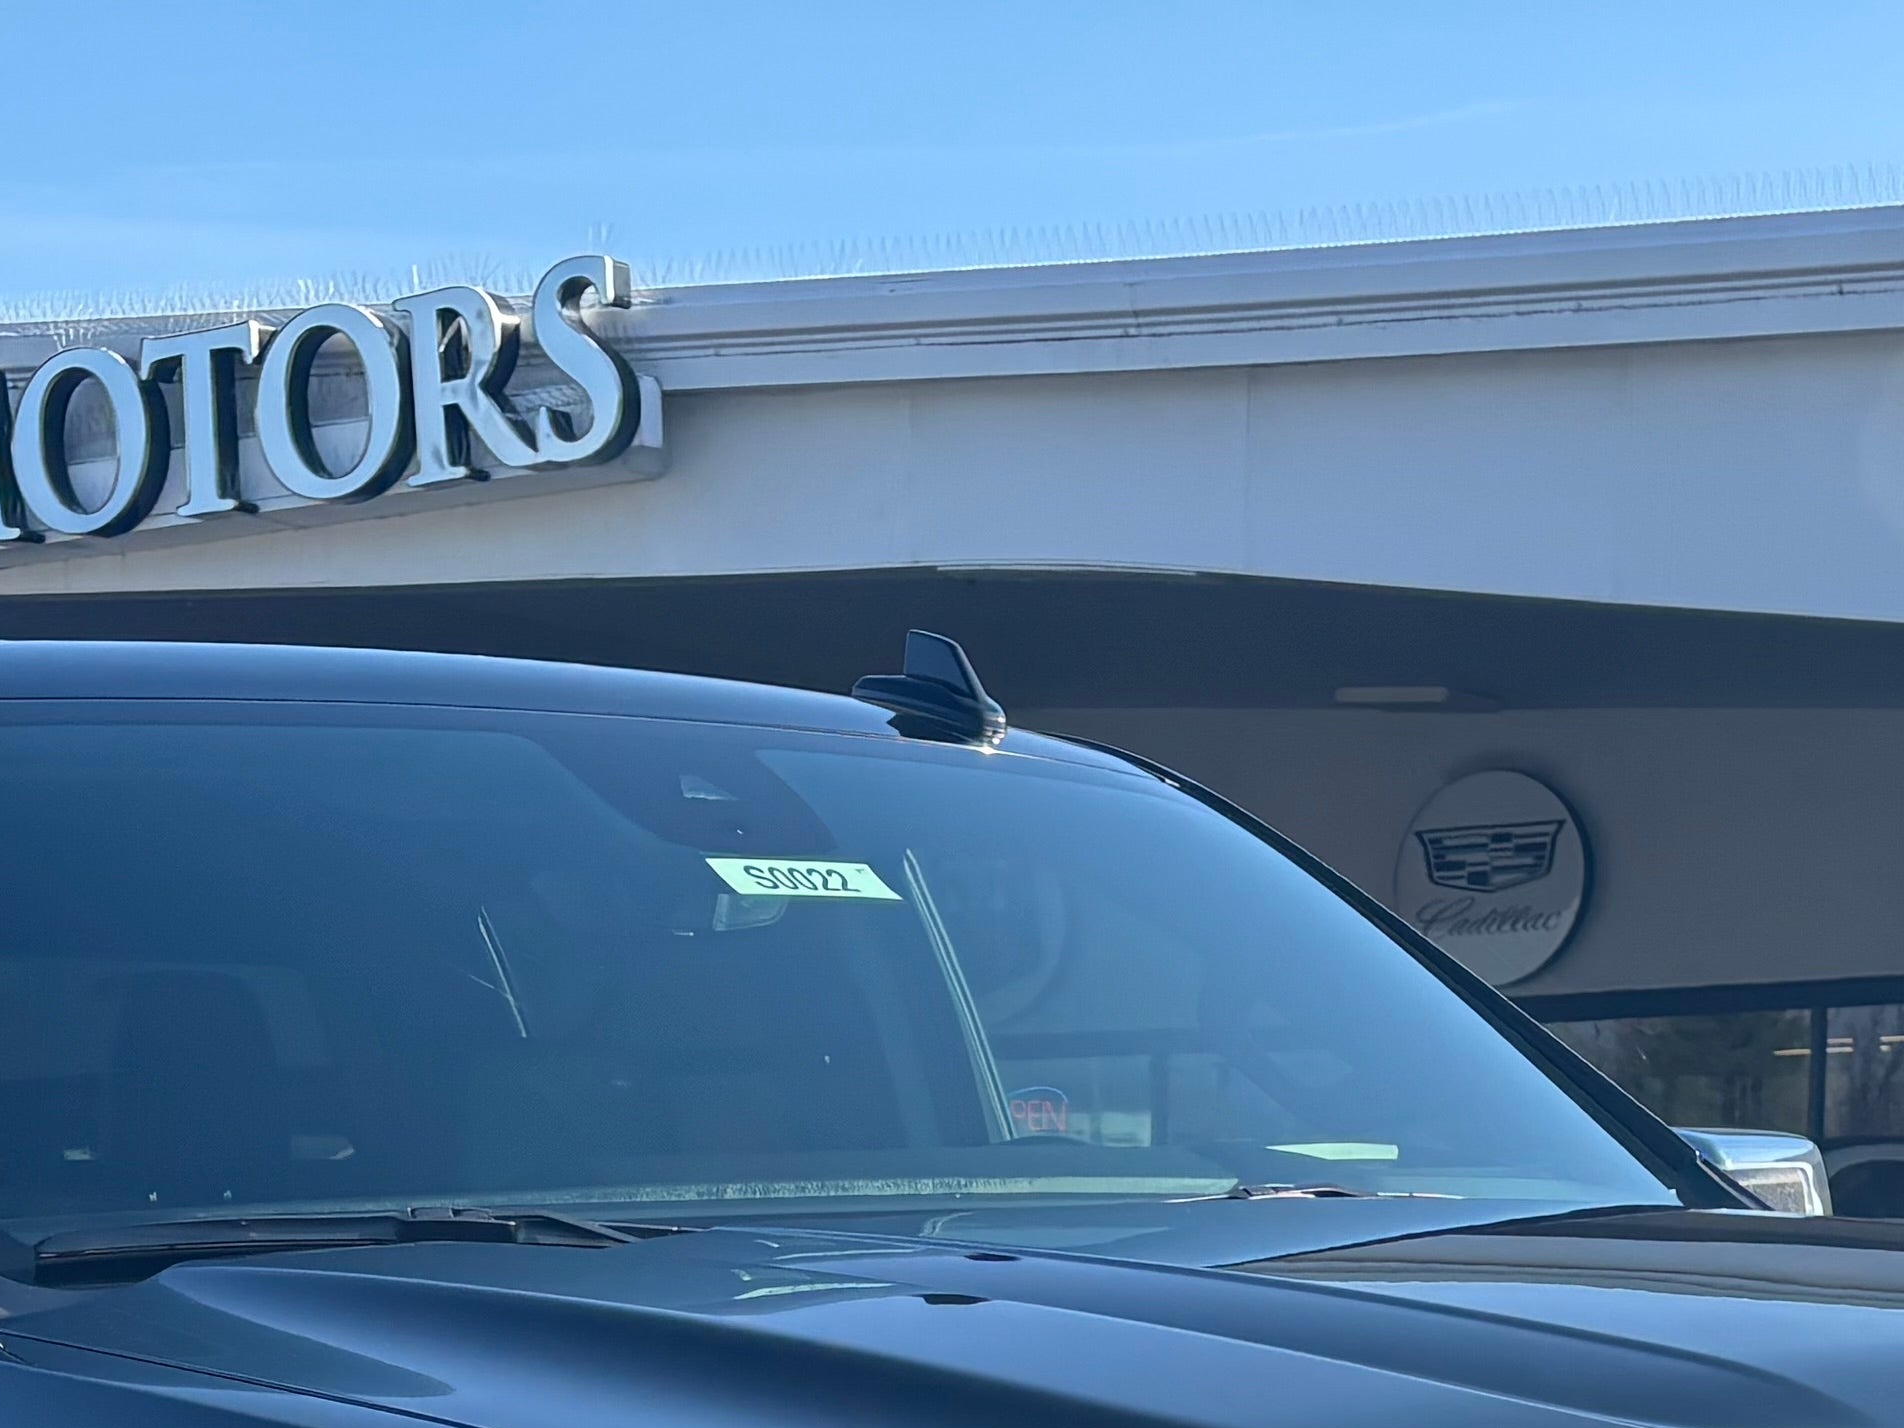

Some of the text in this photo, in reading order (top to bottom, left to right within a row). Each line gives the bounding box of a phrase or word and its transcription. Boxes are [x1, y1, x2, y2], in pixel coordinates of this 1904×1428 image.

[743, 865, 862, 893] S0022
[1416, 897, 1563, 938] Cadillac
[1010, 1100, 1067, 1133] PEN
